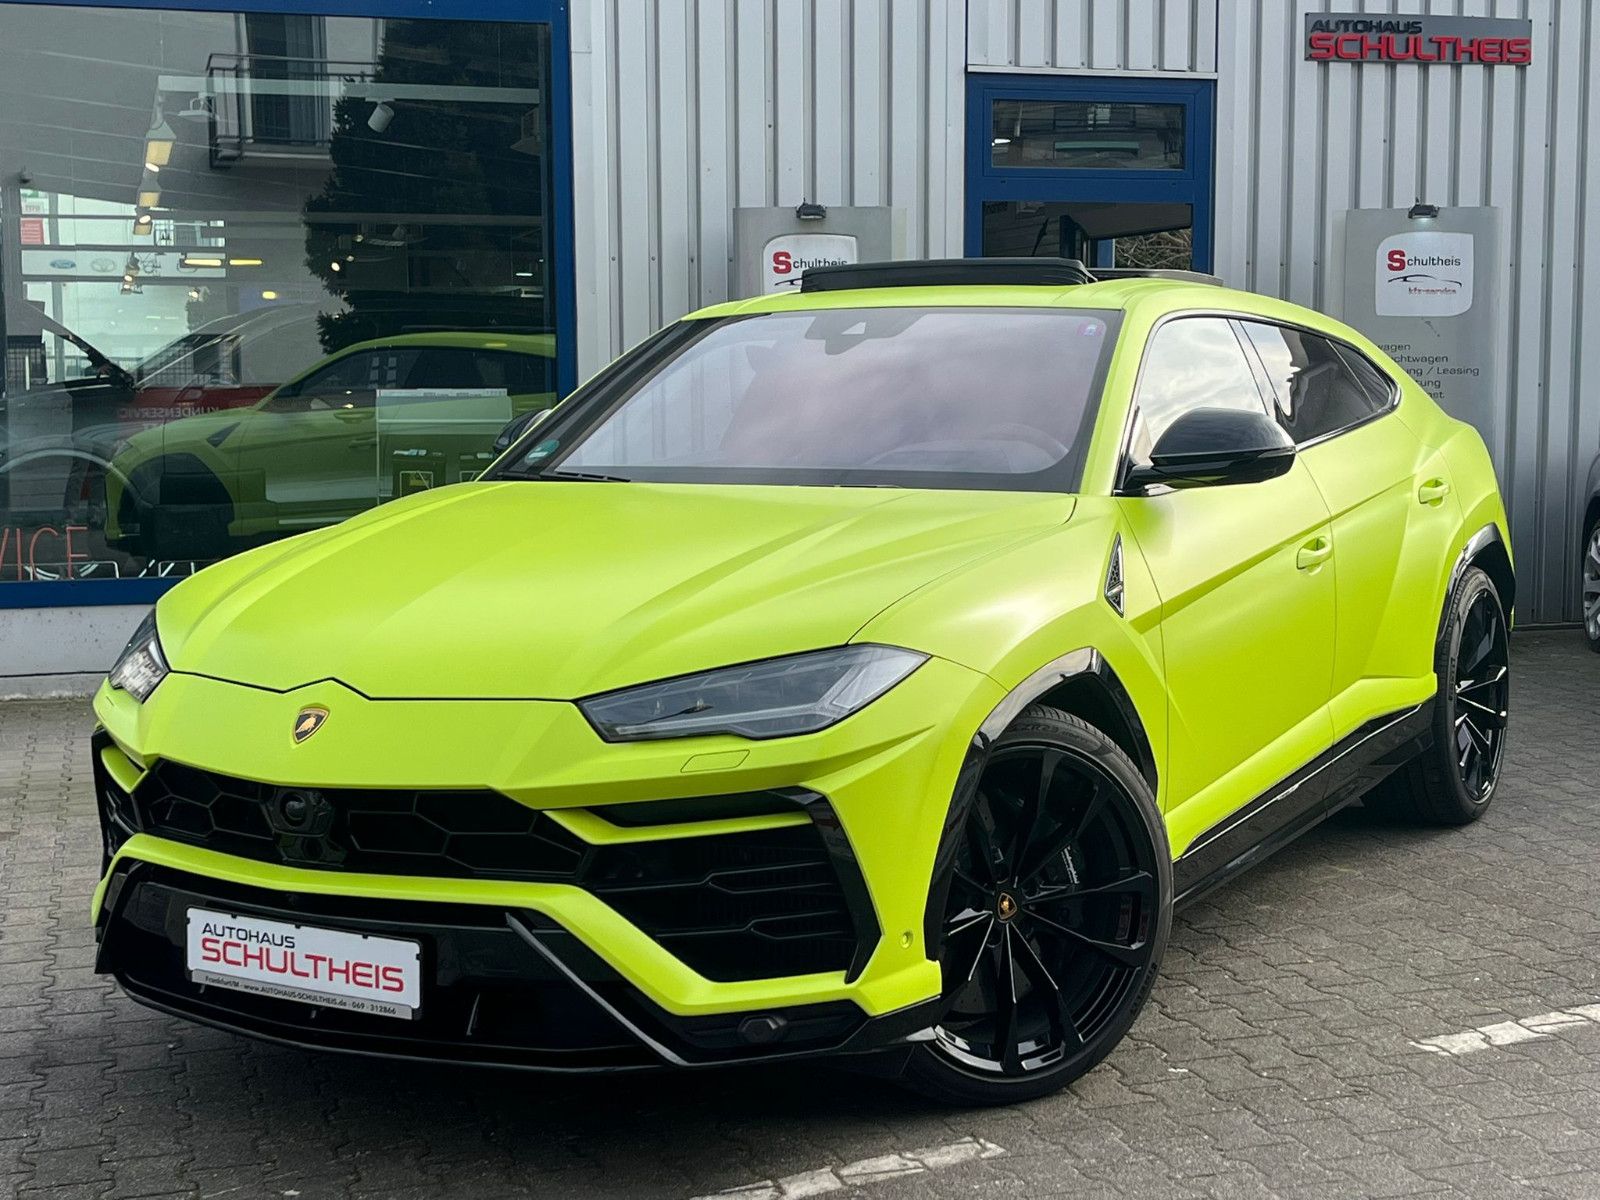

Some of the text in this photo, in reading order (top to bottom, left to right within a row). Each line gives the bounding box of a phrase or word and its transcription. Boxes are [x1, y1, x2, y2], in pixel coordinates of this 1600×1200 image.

[1310, 19, 1423, 34] AUTOHAUS
[1309, 33, 1532, 63] SCHULTHEIS
[1387, 249, 1461, 272] Schultheis
[1436, 366, 1480, 377] Leasing
[201, 922, 296, 949] AUTOHAUS
[201, 937, 405, 993] SCHULTHEIS
